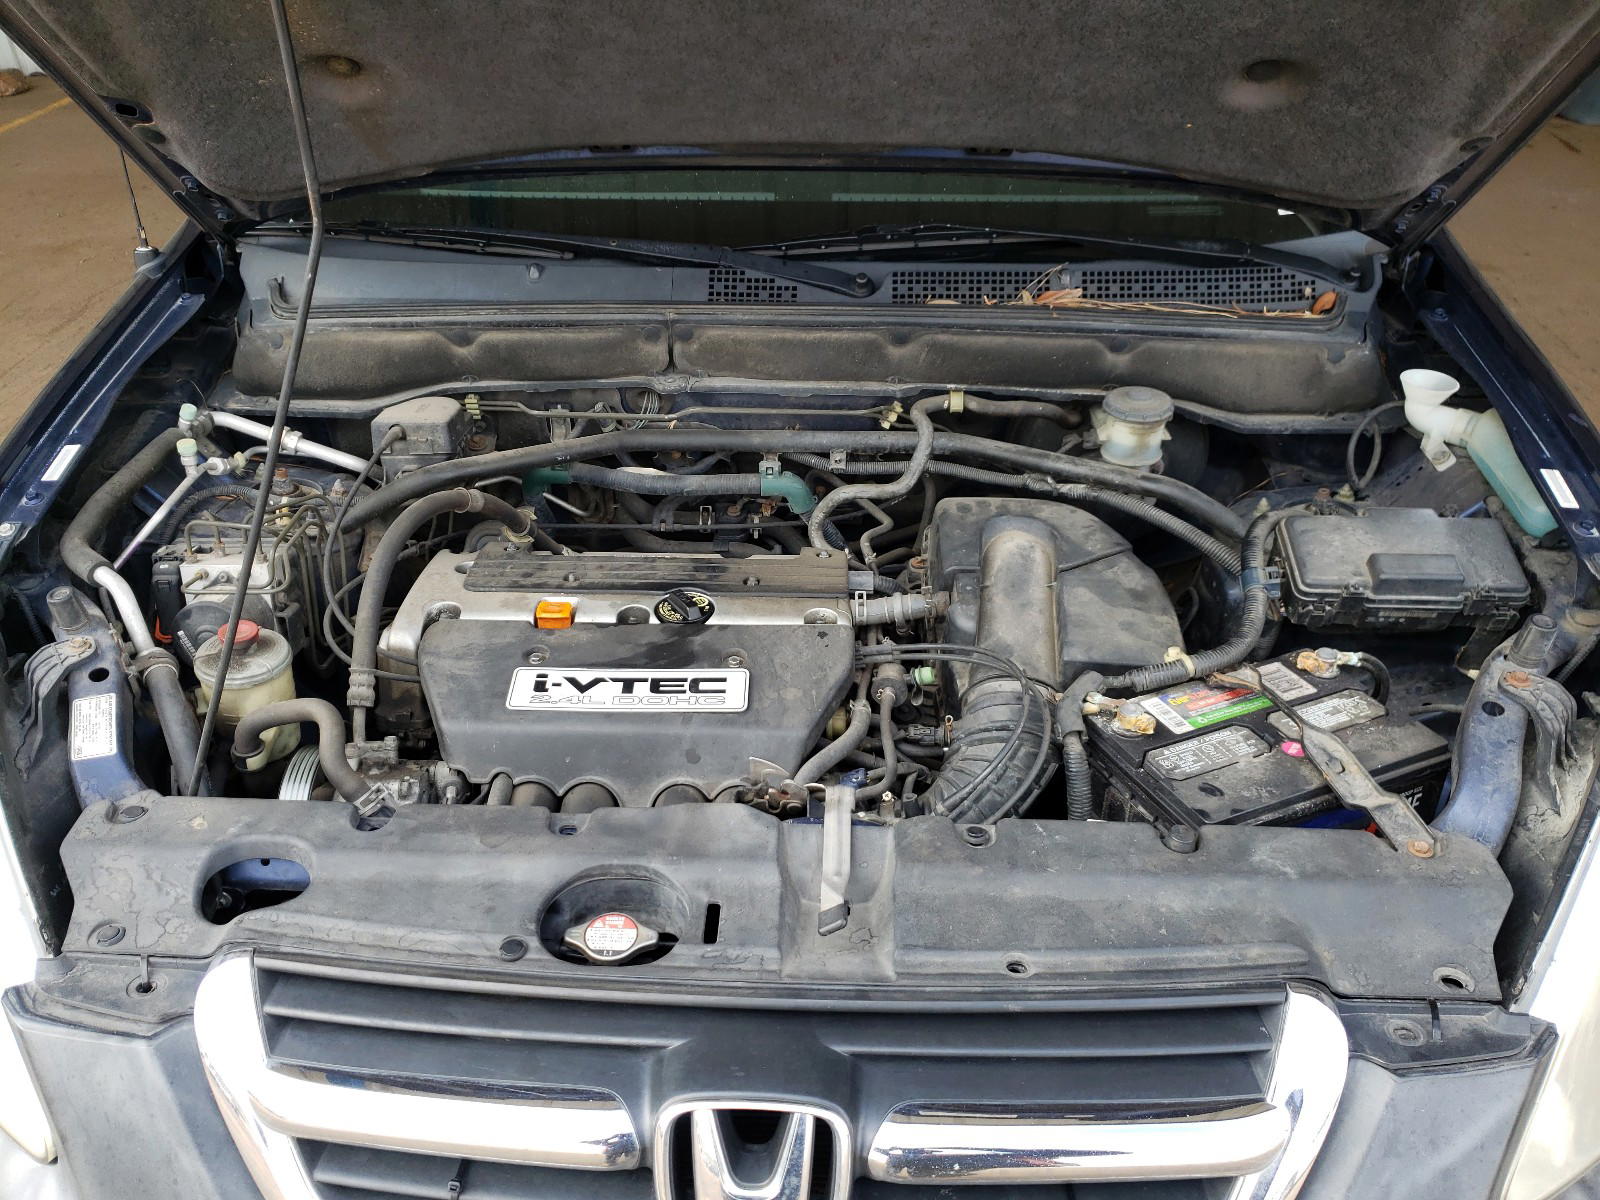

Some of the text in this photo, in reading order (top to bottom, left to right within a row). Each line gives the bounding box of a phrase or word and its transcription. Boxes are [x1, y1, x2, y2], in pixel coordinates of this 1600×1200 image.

[533, 673, 727, 695] i-VTEC
[529, 694, 727, 706] 2.4L DOHC
[1171, 740, 1199, 755] DANGER
